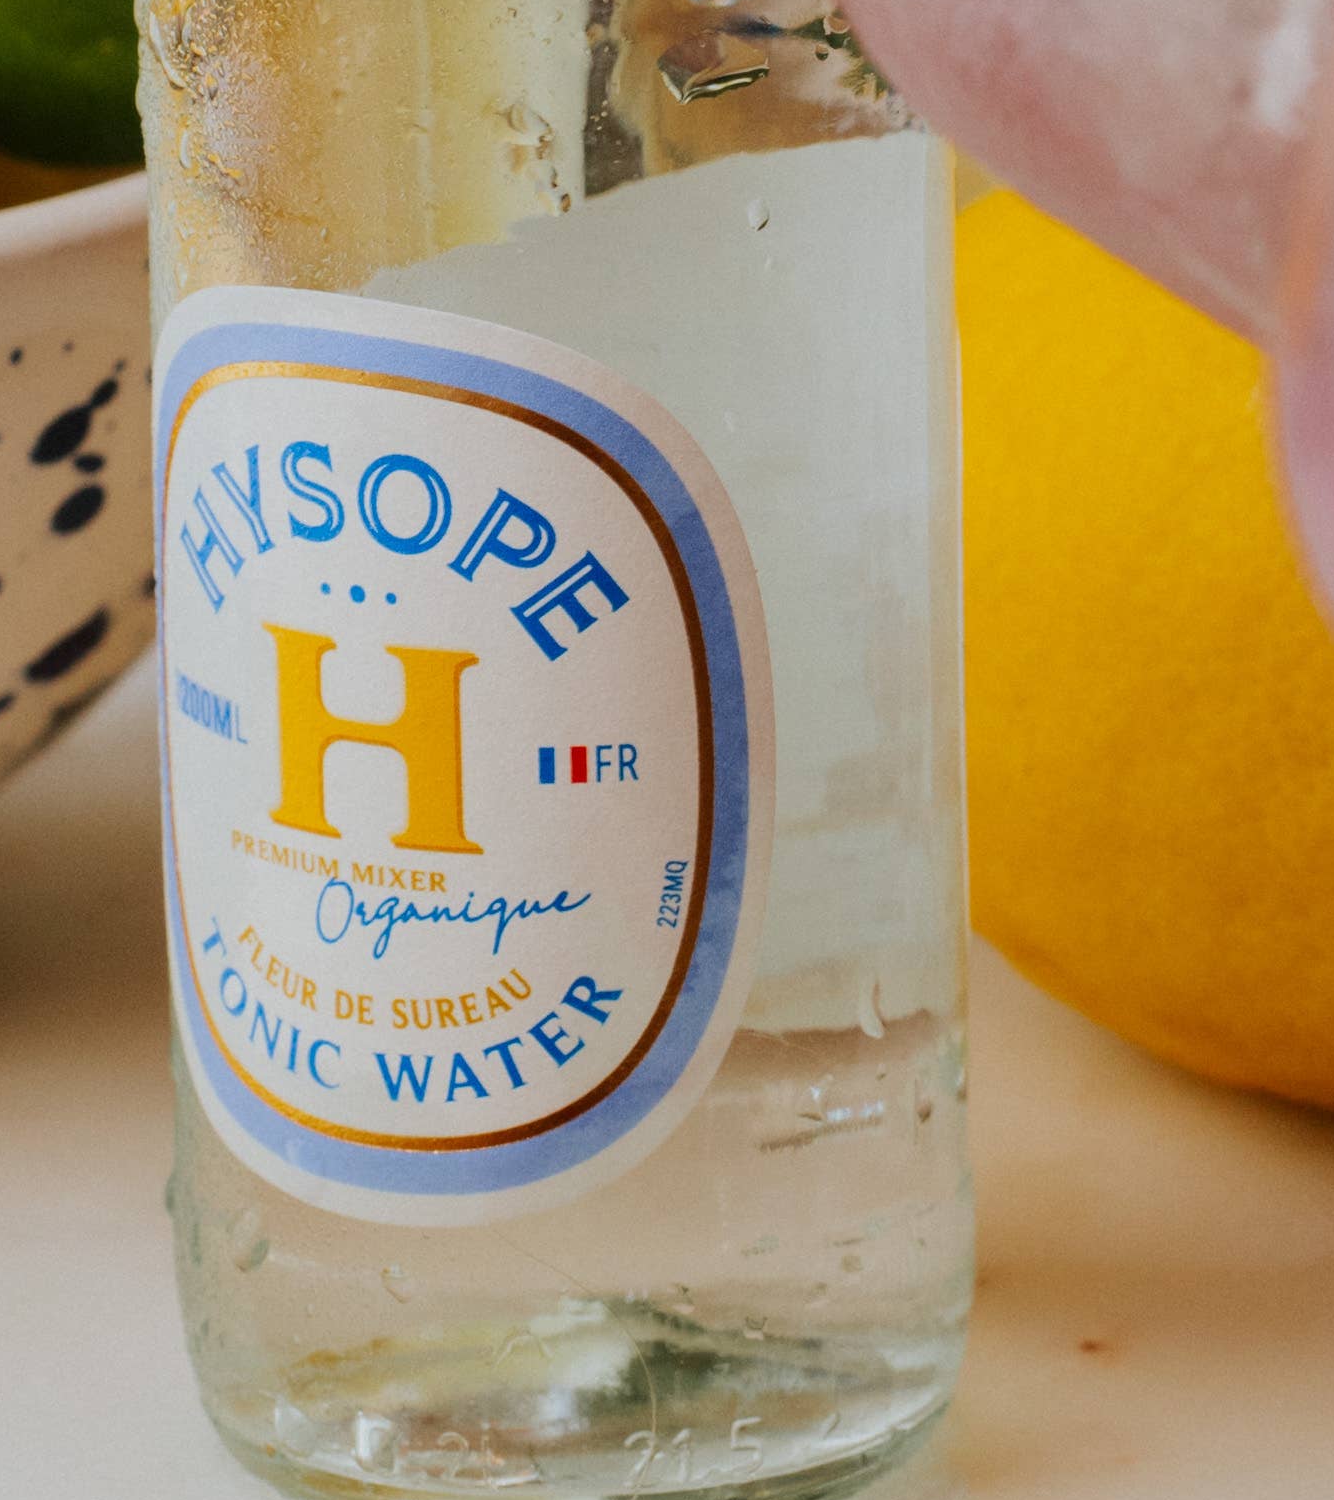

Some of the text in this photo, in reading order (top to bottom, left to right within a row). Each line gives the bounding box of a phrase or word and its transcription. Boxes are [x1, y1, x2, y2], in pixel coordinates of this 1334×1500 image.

[179, 440, 631, 663] HYSOPE
[261, 620, 485, 854] H
[595, 743, 640, 783] FR
[231, 829, 448, 893] PREMIUM MIXER
[656, 860, 689, 929] 223MQ
[315, 876, 592, 959] Organique
[202, 915, 625, 1104] TONIC WATER
[238, 924, 533, 1031] FLEUR DE SUREAU
